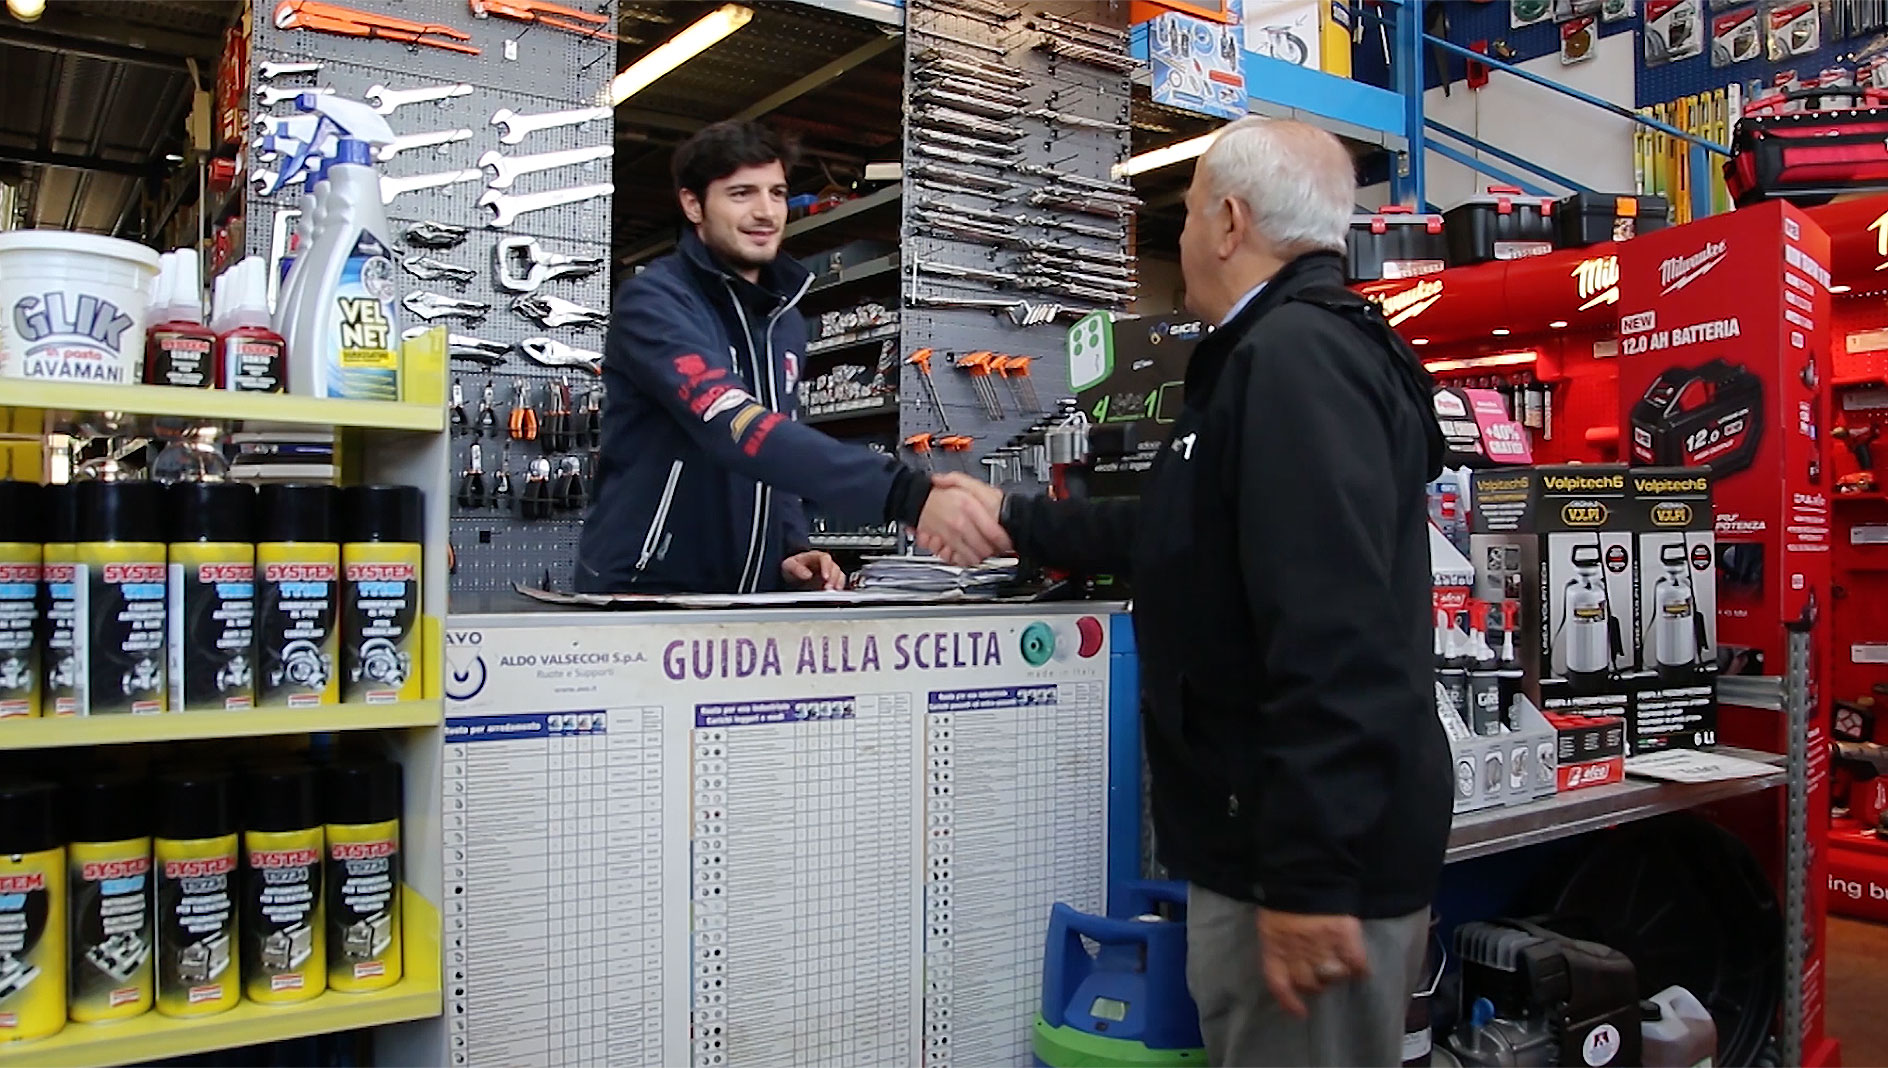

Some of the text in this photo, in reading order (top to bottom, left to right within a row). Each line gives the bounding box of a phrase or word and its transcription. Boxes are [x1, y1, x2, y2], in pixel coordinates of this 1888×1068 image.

[14, 291, 134, 352] GLIK
[338, 296, 388, 325] VEL
[1623, 311, 1654, 331] NEW
[341, 321, 390, 350] NET
[1622, 318, 1740, 355] 12.0 AH BATTERIA
[23, 360, 124, 383] LAVAMANI
[1685, 428, 1720, 453] 12.0
[1544, 475, 1624, 491] Volpitech6
[1634, 478, 1708, 494] Volpitech6
[266, 562, 336, 582] SYSTEM
[347, 562, 416, 582] SYSTEM
[500, 655, 536, 667] ALDO
[541, 653, 609, 665] VALSECCHI
[663, 631, 1001, 680] GUIDA ALLA SCELTA
[0, 872, 45, 893] TEM
[1828, 874, 1862, 899] ing
